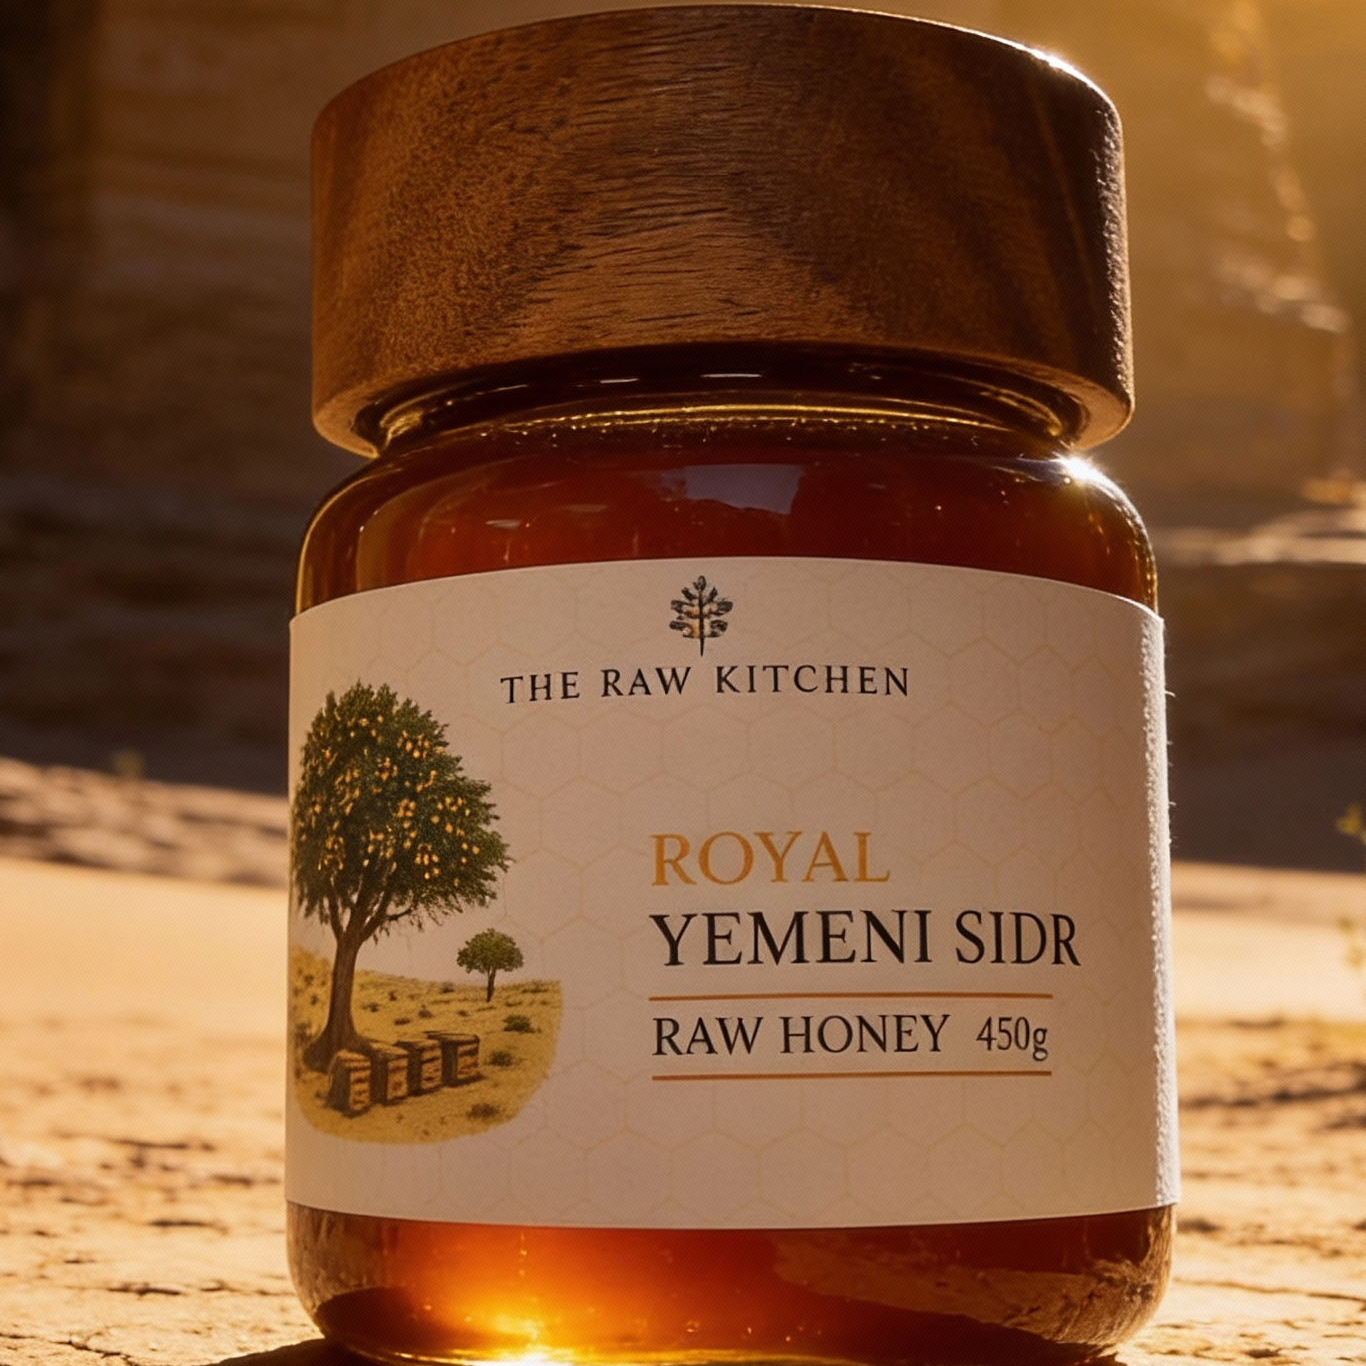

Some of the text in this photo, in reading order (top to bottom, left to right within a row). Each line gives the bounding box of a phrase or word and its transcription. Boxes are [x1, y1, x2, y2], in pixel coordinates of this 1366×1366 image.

[500, 664, 911, 705] THE RAW KITCHEN
[650, 830, 892, 887] ROYAL
[649, 909, 1082, 968] YEMENI SIDR
[651, 1013, 1049, 1063] RAW HONEY 450g
